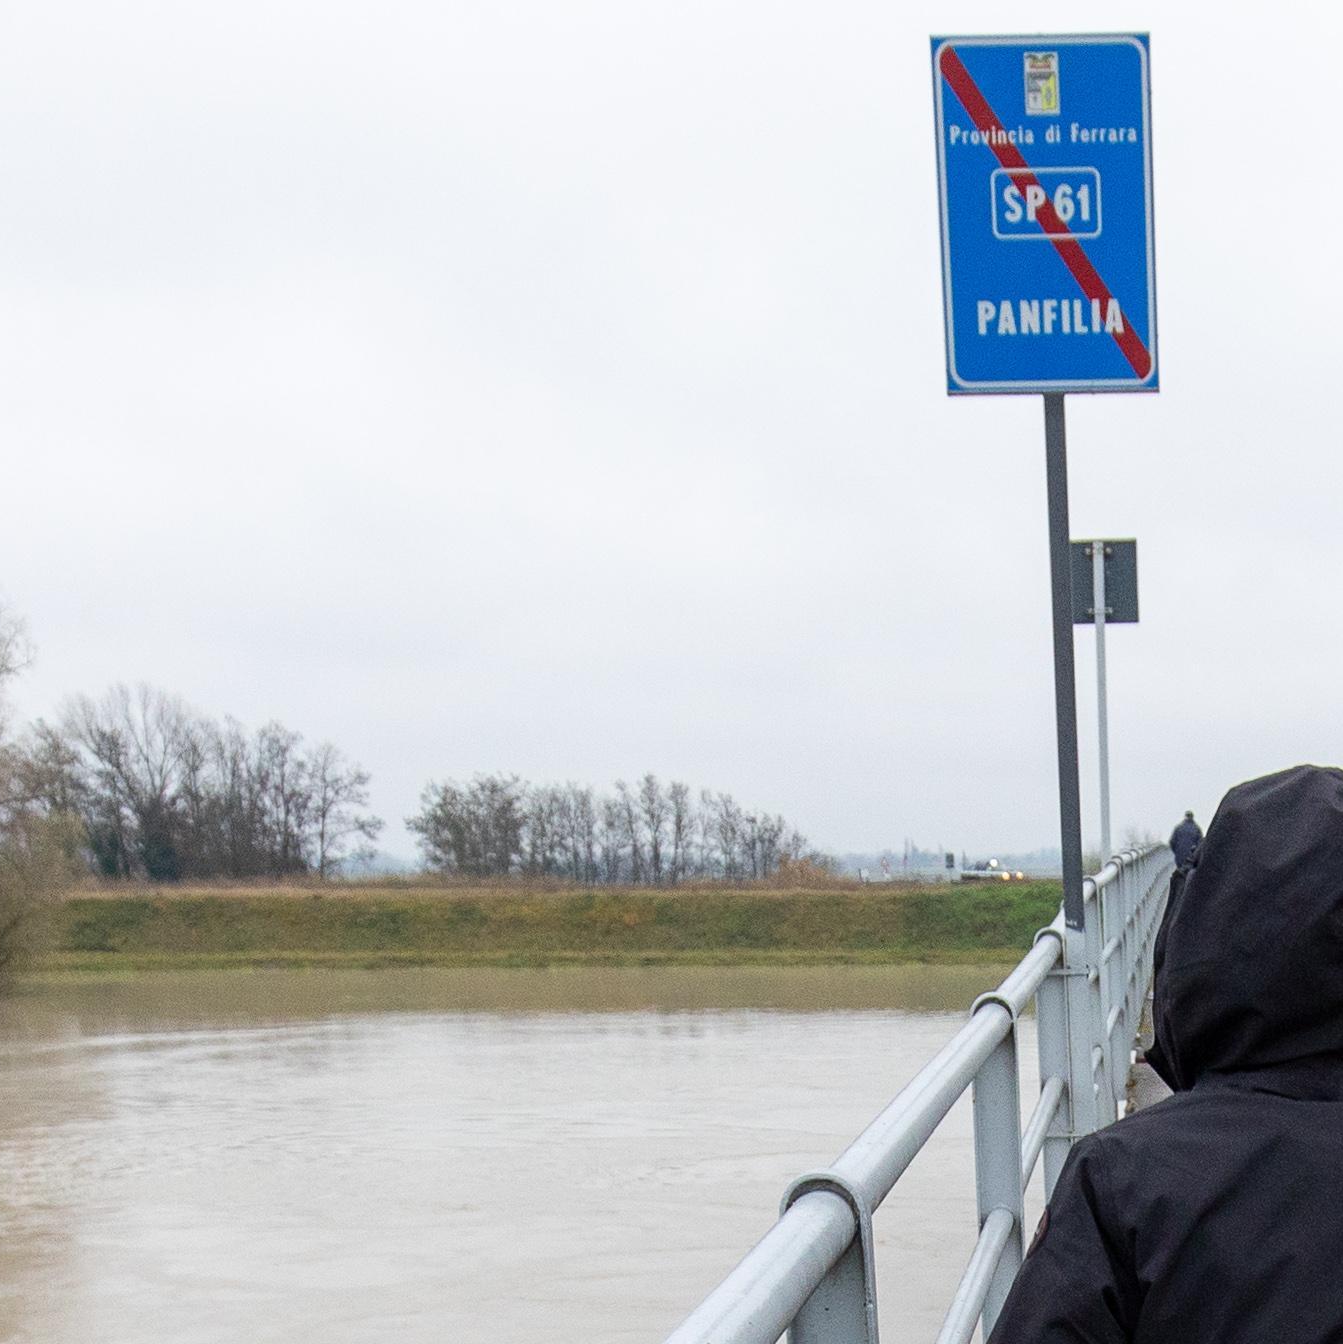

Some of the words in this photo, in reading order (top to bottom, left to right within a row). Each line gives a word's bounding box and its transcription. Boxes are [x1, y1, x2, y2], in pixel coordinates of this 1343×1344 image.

[949, 125, 1035, 145] Provincia
[1045, 125, 1061, 144] di
[1070, 122, 1138, 143] Ferrara
[977, 298, 1125, 335] PANFILIA
